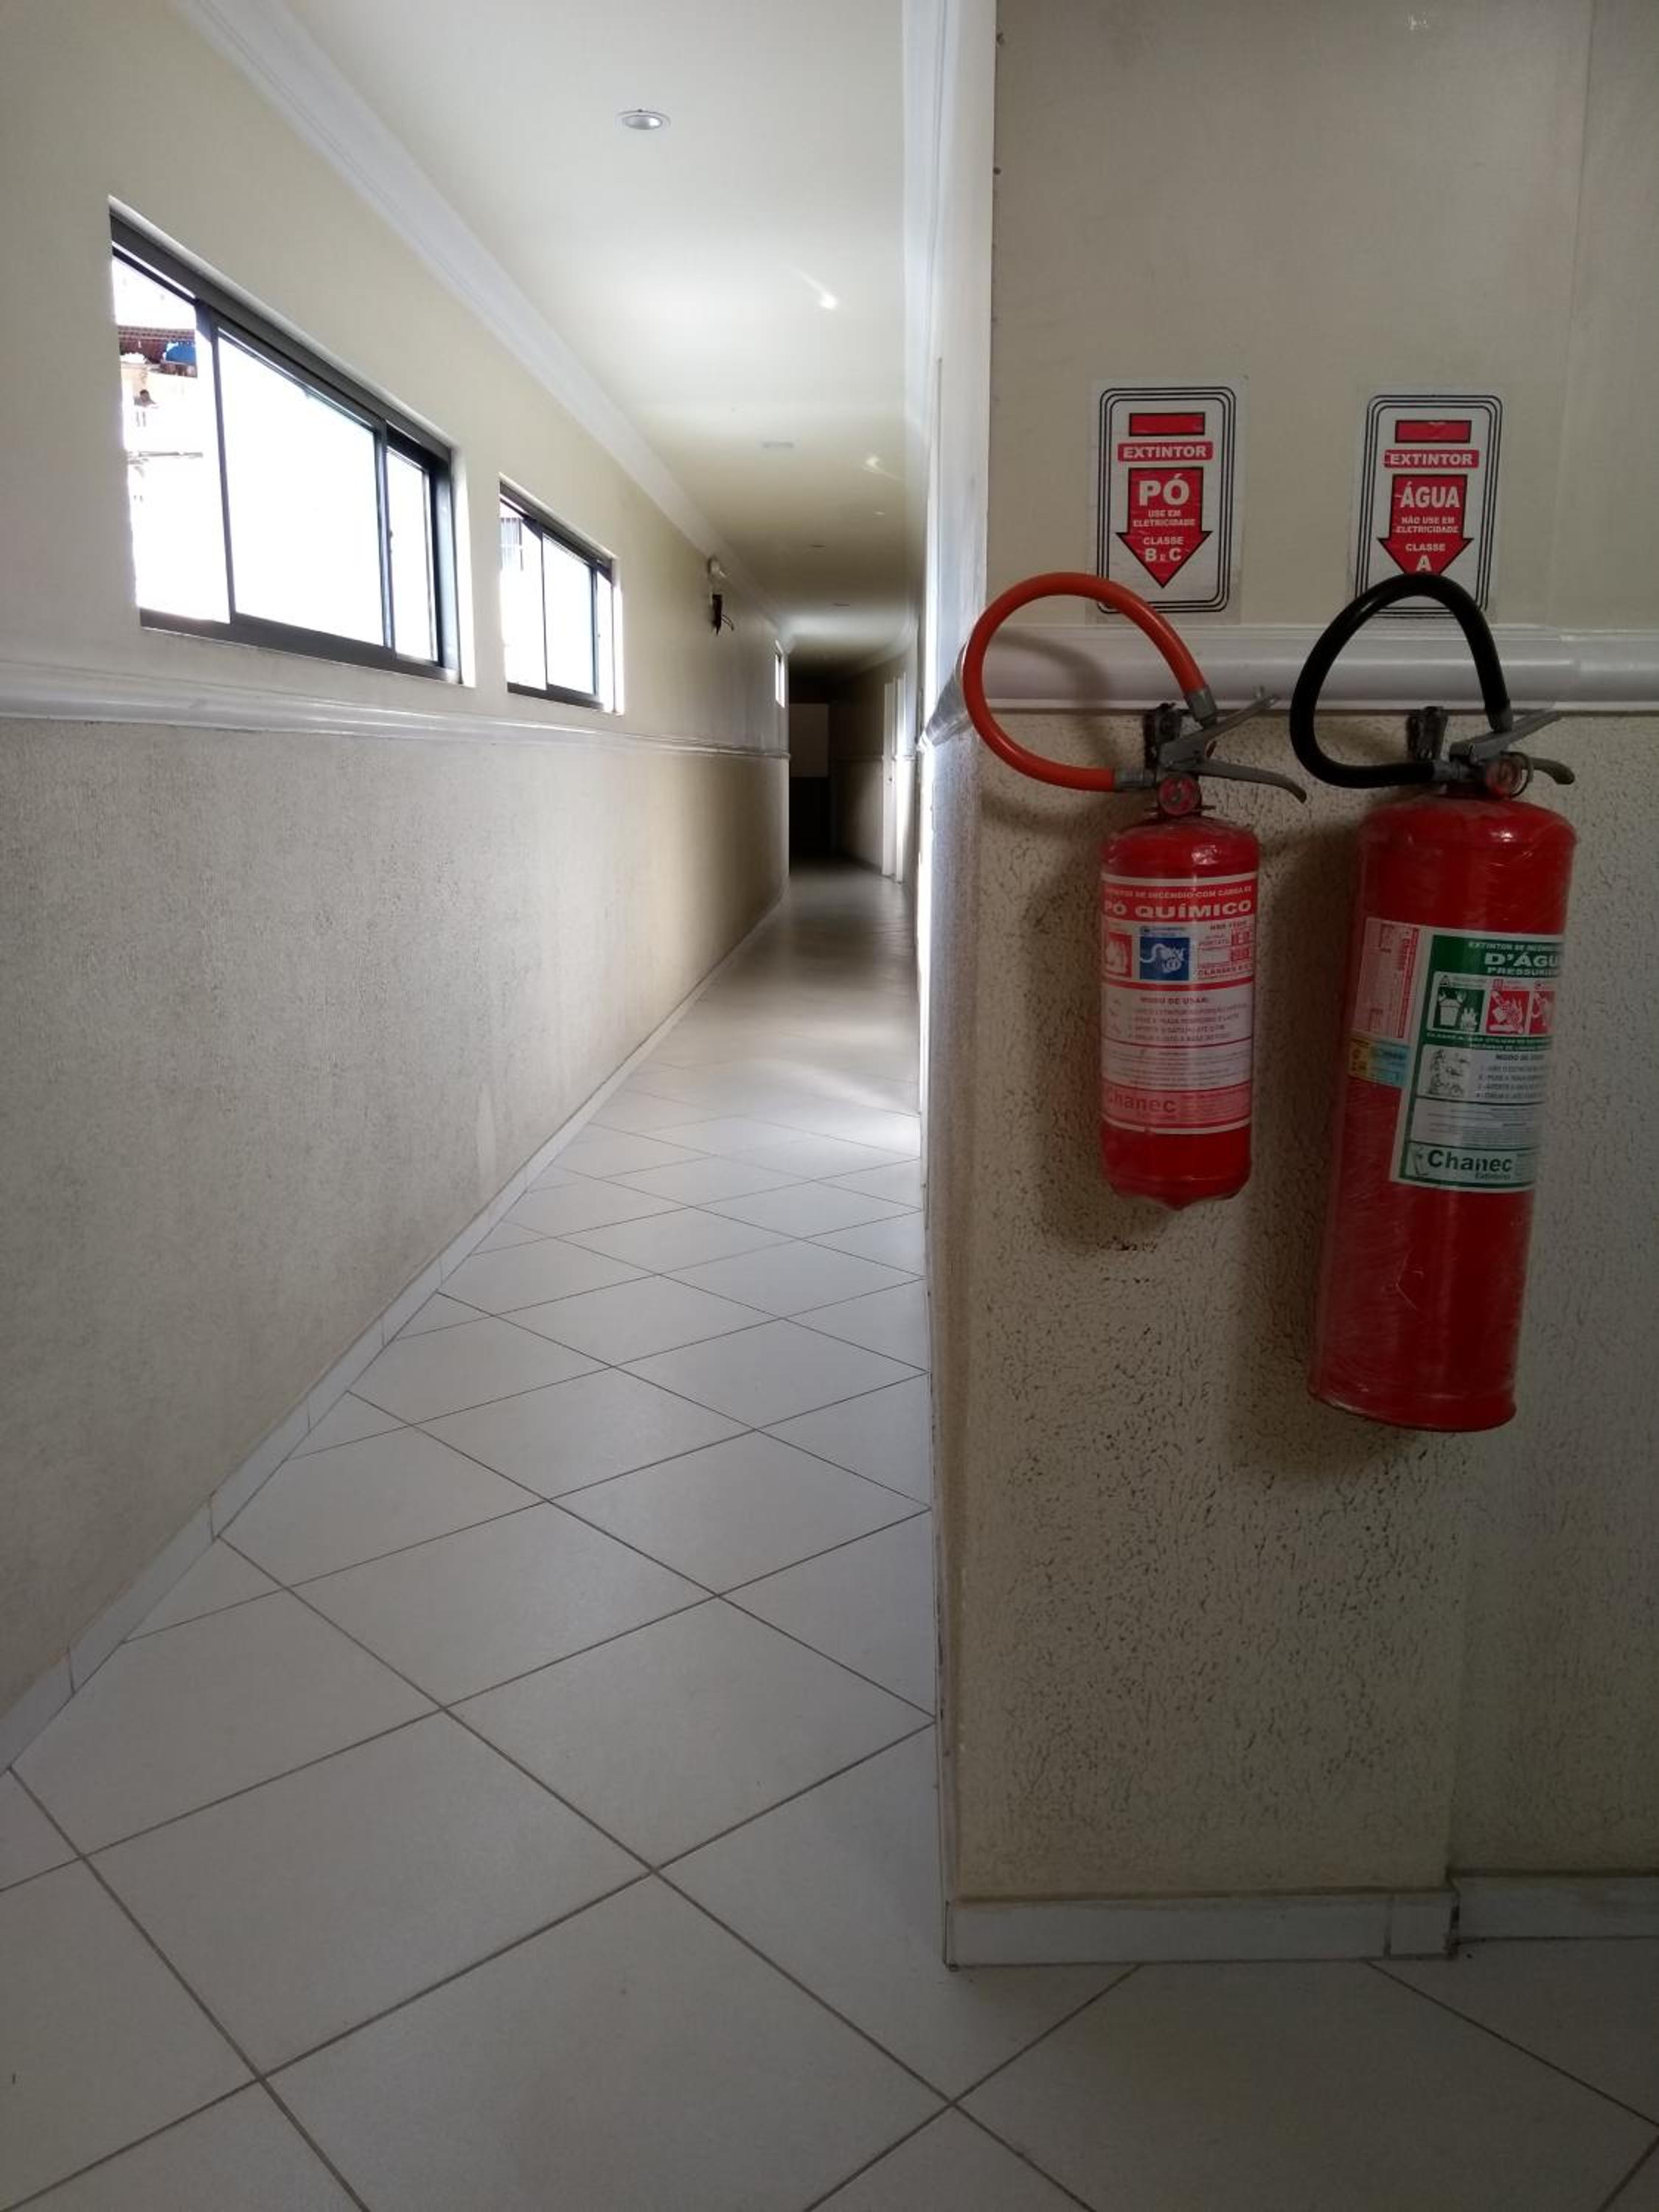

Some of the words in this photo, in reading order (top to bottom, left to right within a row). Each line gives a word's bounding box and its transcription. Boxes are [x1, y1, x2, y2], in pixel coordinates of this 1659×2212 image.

[1123, 445, 1207, 459] EXTINTOR
[1390, 453, 1473, 466] EXTINTOR
[1138, 473, 1189, 507] PÓ
[1400, 481, 1460, 508] ÁGUA
[1148, 509, 1166, 518] USE
[1167, 509, 1181, 517] EM
[1401, 515, 1420, 524] NÃO
[1422, 516, 1439, 524] USE
[1441, 516, 1455, 524] EM
[1133, 518, 1195, 527] ELETRICIDADE
[1396, 525, 1459, 533] ELETRICIDADE
[1143, 536, 1184, 545] CLASSE
[1405, 543, 1446, 552] CLASSE
[1145, 547, 1157, 562] B
[1169, 547, 1182, 562] C
[1416, 554, 1433, 572] A
[1105, 897, 1127, 916] PÓ
[1135, 899, 1252, 919] QUÍMICO
[1427, 1149, 1513, 1172] Chanec
